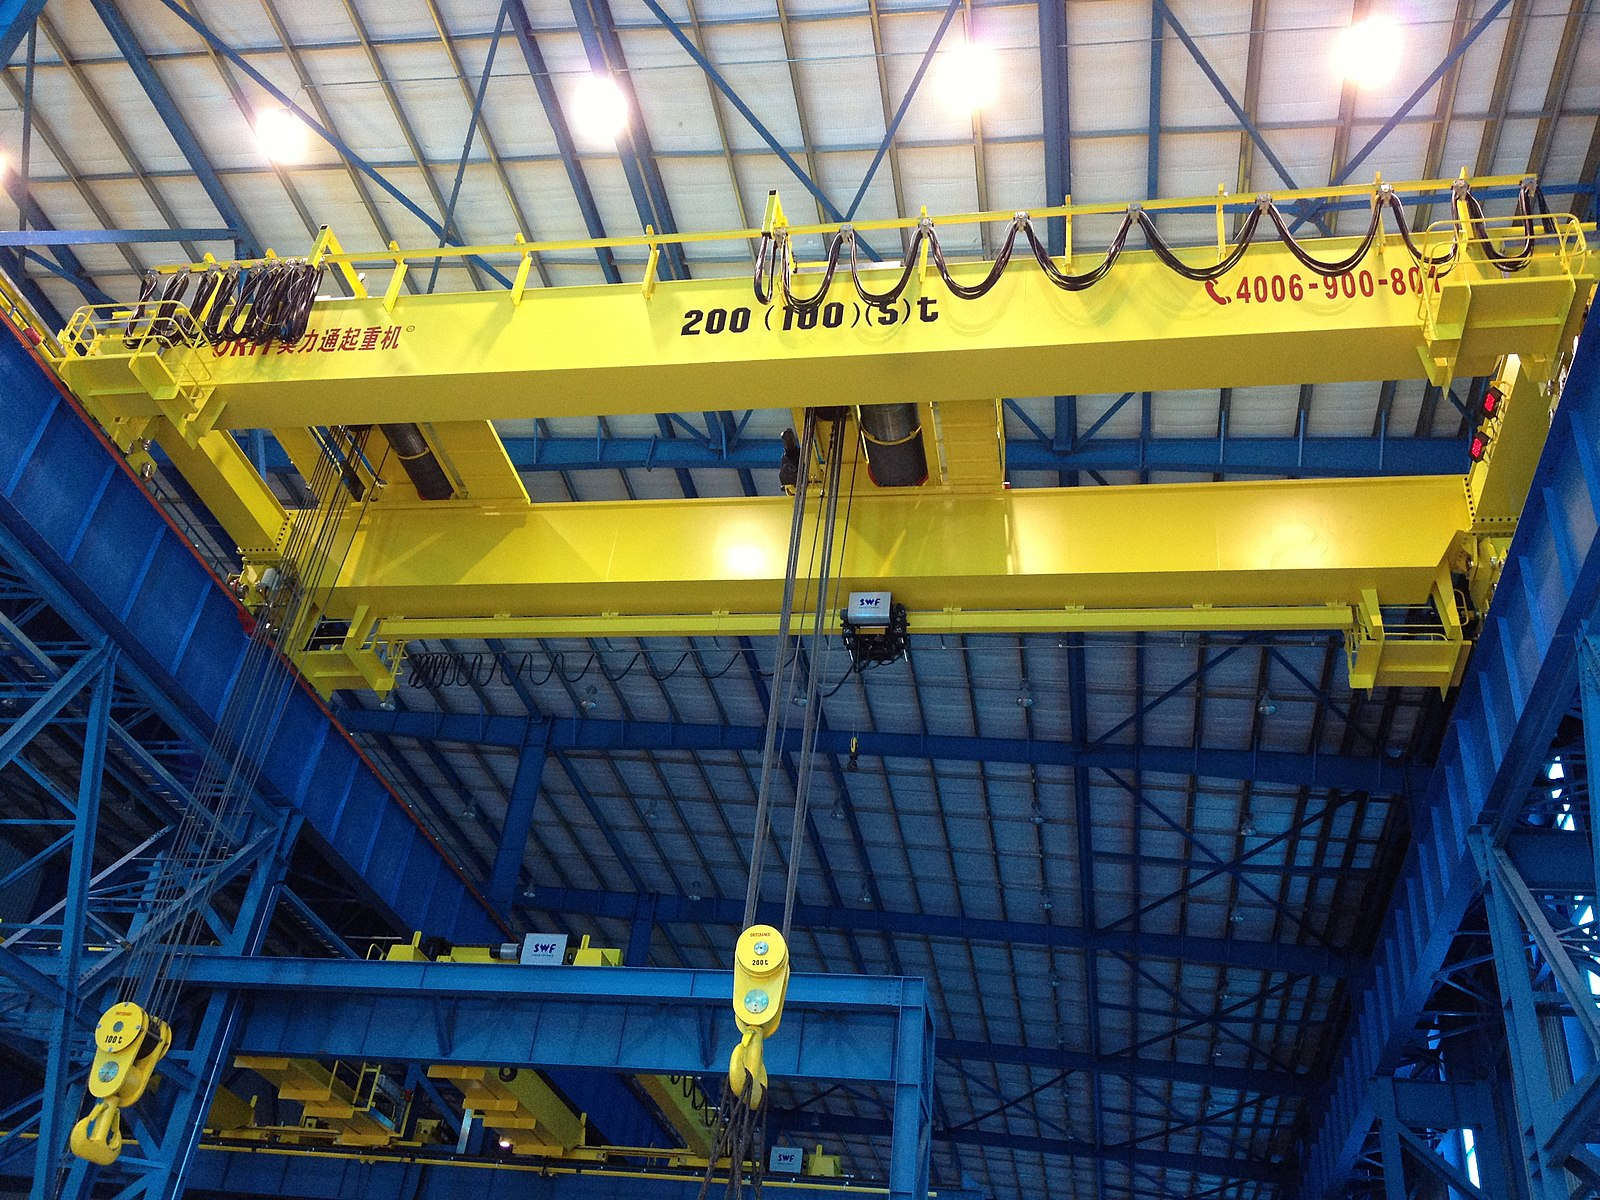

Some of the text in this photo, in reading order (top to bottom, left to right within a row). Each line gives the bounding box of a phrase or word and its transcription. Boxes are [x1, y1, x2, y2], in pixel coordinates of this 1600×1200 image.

[859, 598, 881, 606] SWF
[533, 943, 556, 953] SWF
[777, 1153, 795, 1162] SWF
